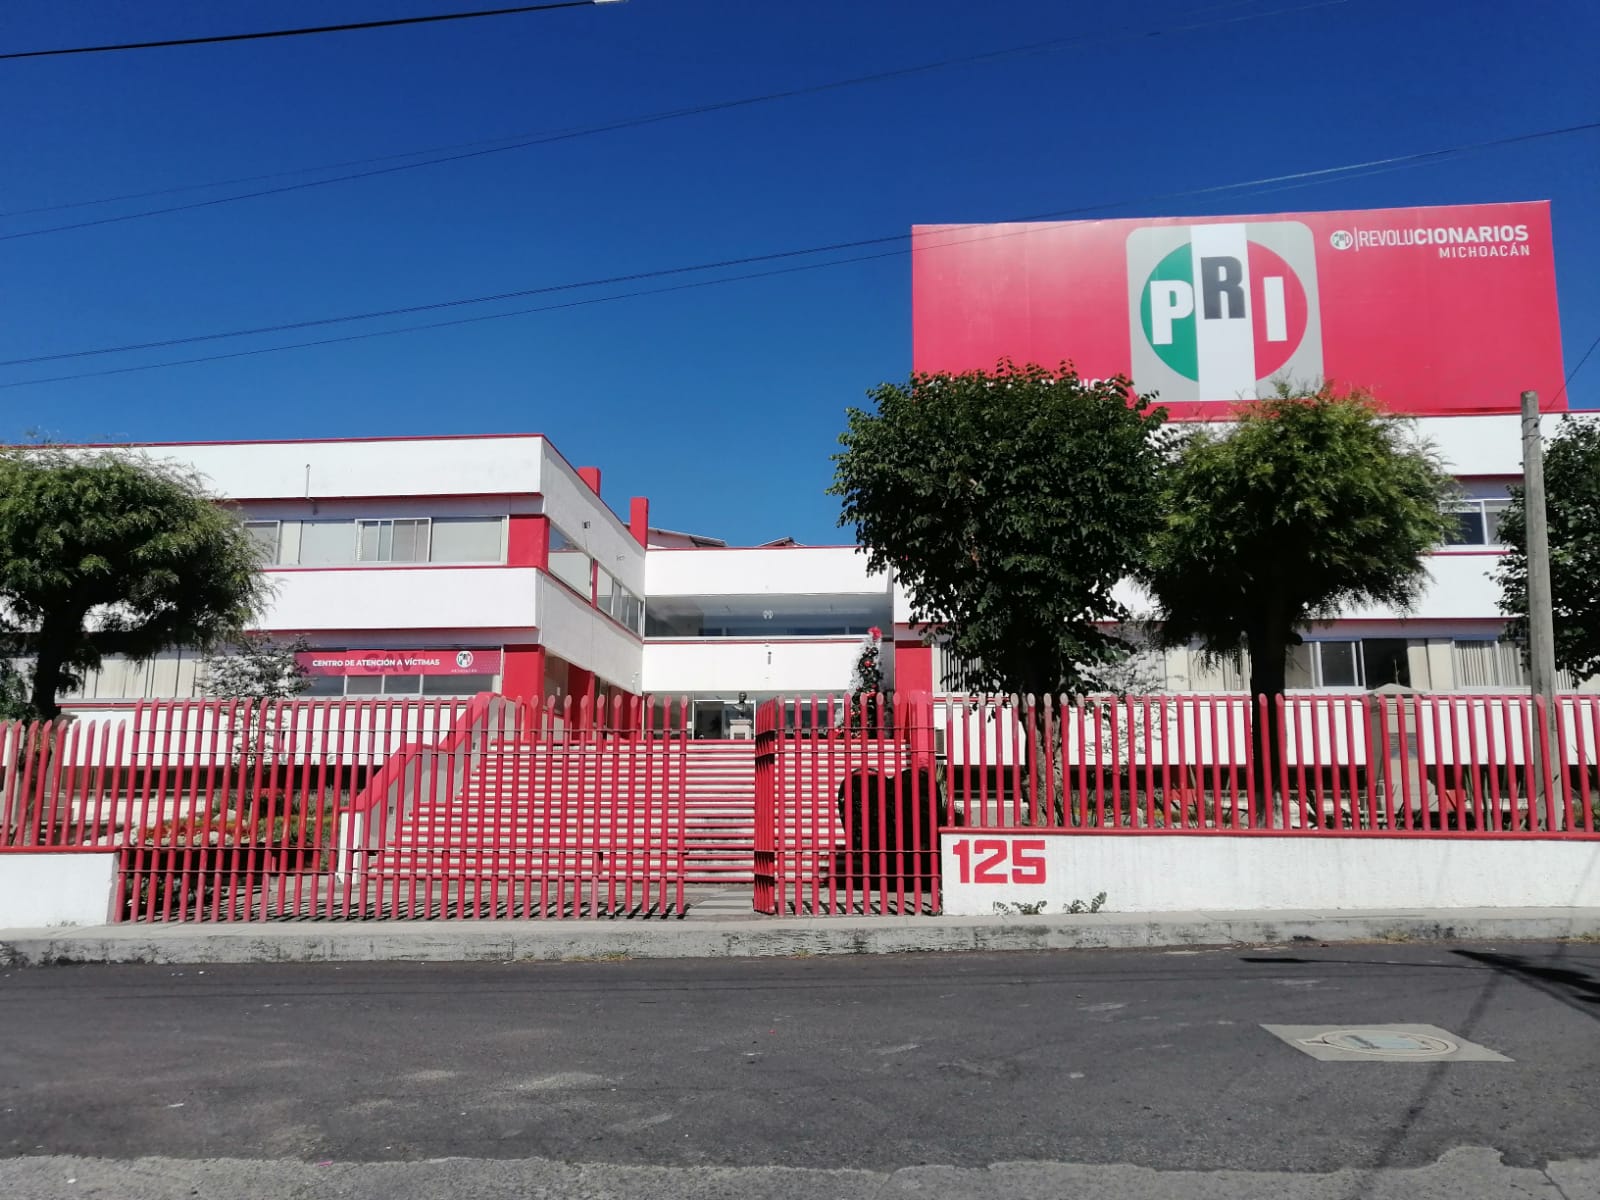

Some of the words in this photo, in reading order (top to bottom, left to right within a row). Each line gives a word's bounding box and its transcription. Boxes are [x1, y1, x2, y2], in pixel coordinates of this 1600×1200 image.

[1359, 225, 1529, 247] REVOLUCIONARIOS
[1439, 242, 1531, 259] MICHOACÁN
[1150, 256, 1288, 345] PRI
[344, 659, 355, 667] DE
[356, 658, 395, 667] ATENCIÓN
[404, 658, 441, 666] VÍCTIMAS
[952, 839, 1047, 884] 125
